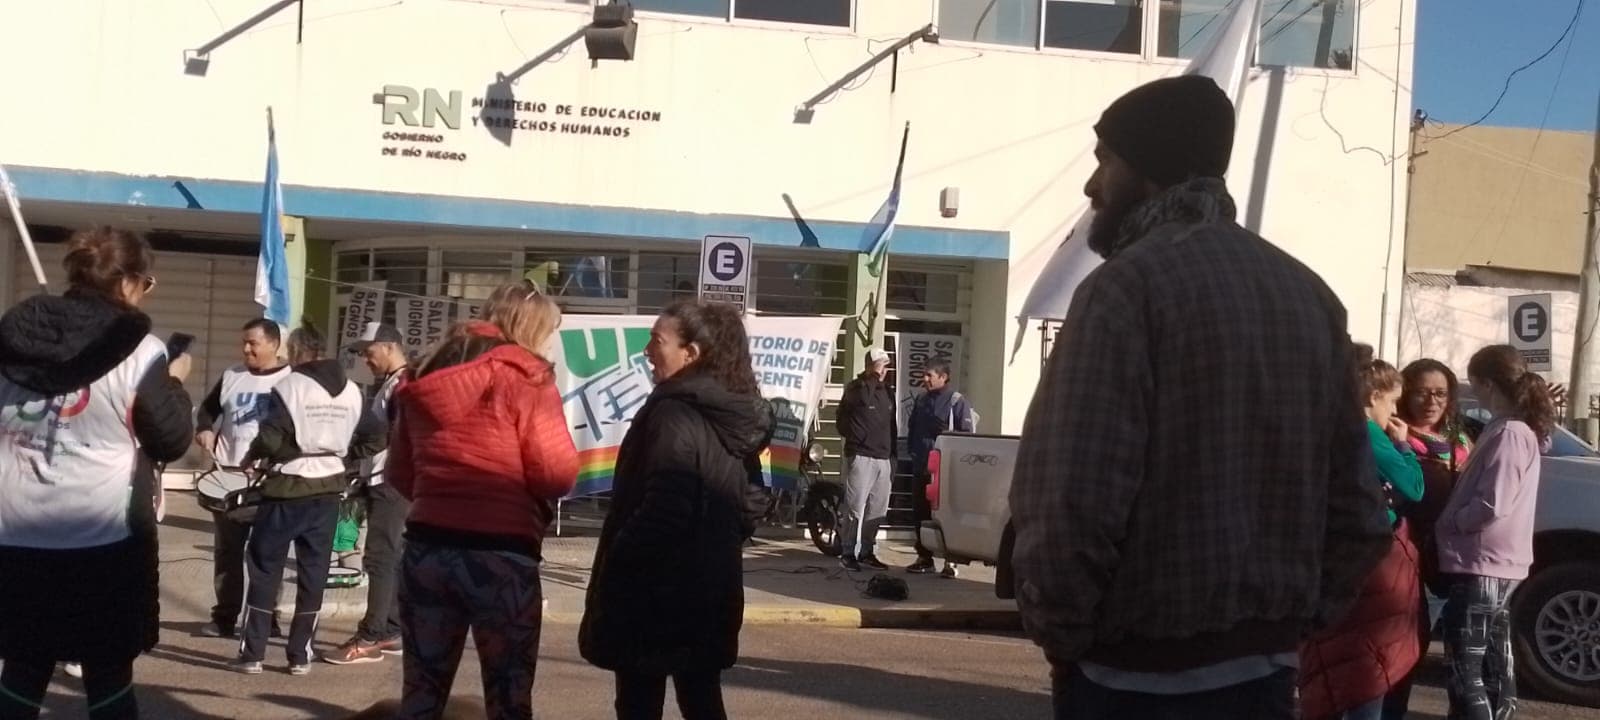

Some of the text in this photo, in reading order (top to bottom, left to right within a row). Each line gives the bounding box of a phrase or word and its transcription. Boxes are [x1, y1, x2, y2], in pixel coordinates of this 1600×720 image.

[373, 84, 463, 130] RN
[471, 97, 662, 122] MINISTERIO DE EDUCACION
[382, 131, 444, 143] GOBIERNO
[471, 116, 631, 138] Y DERECHOS HUMANOS
[381, 147, 398, 156] DE
[426, 150, 467, 161] NEGRO
[716, 249, 736, 274] E
[346, 291, 365, 338] DIGNOS
[407, 300, 424, 346] DIGNOS
[1521, 308, 1539, 336] E
[749, 335, 830, 356] TORIO DE
[751, 352, 814, 373] TANCIA
[909, 340, 930, 388] DIGNOS
[753, 371, 804, 390] CENTE
